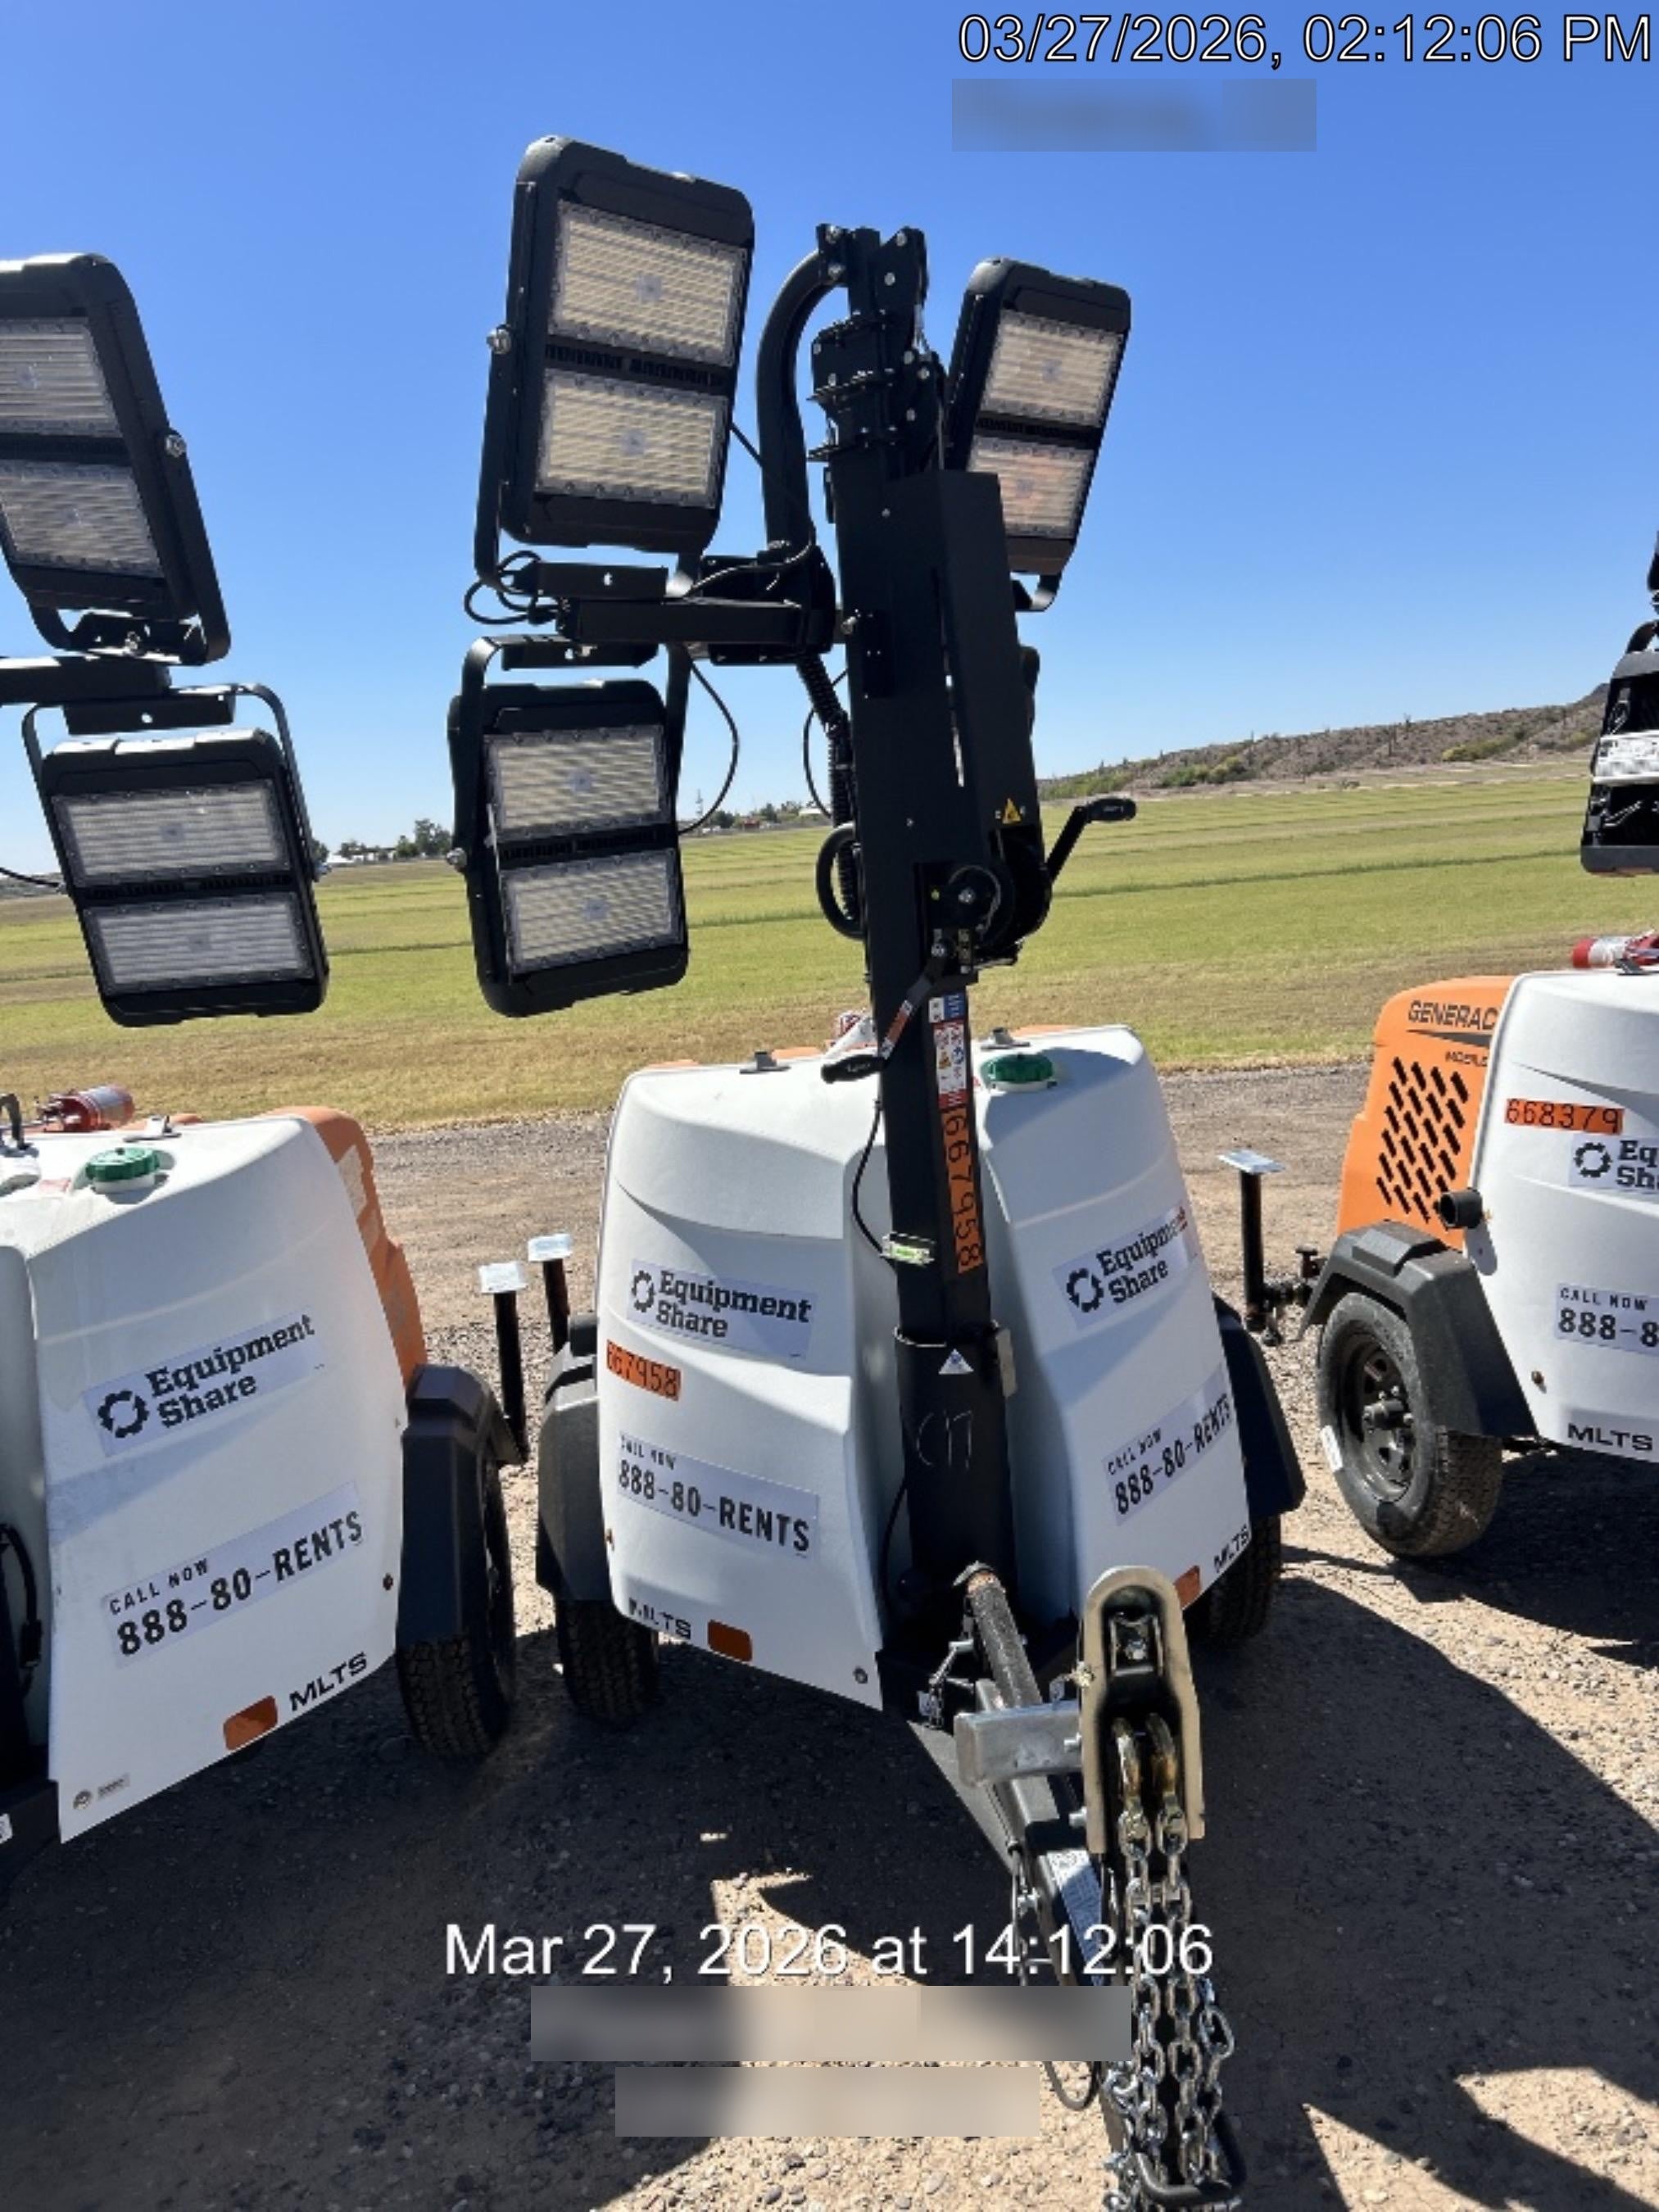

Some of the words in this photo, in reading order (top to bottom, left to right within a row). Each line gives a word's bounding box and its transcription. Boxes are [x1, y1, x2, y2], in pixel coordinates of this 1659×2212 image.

[1408, 999, 1498, 1030] GENERAC
[1507, 1099, 1620, 1134] 668379
[945, 1114, 980, 1267] 667958
[660, 1271, 811, 1322] Equipment
[1108, 1260, 1168, 1303] Share
[1560, 1288, 1601, 1306] CALL
[1610, 1294, 1648, 1311] NOW
[656, 1301, 728, 1337] Share
[145, 1314, 315, 1397] Equipment
[156, 1375, 257, 1428] Share
[1115, 1394, 1231, 1515] 888-80-RENTS
[1568, 1423, 1653, 1451] MLTS
[619, 1459, 809, 1552] 888-80-RENTS
[109, 1582, 161, 1614] CALL
[168, 1558, 208, 1588] NOW
[117, 1511, 362, 1656] 888-80-RENTS
[289, 1651, 368, 1711] MLTS
